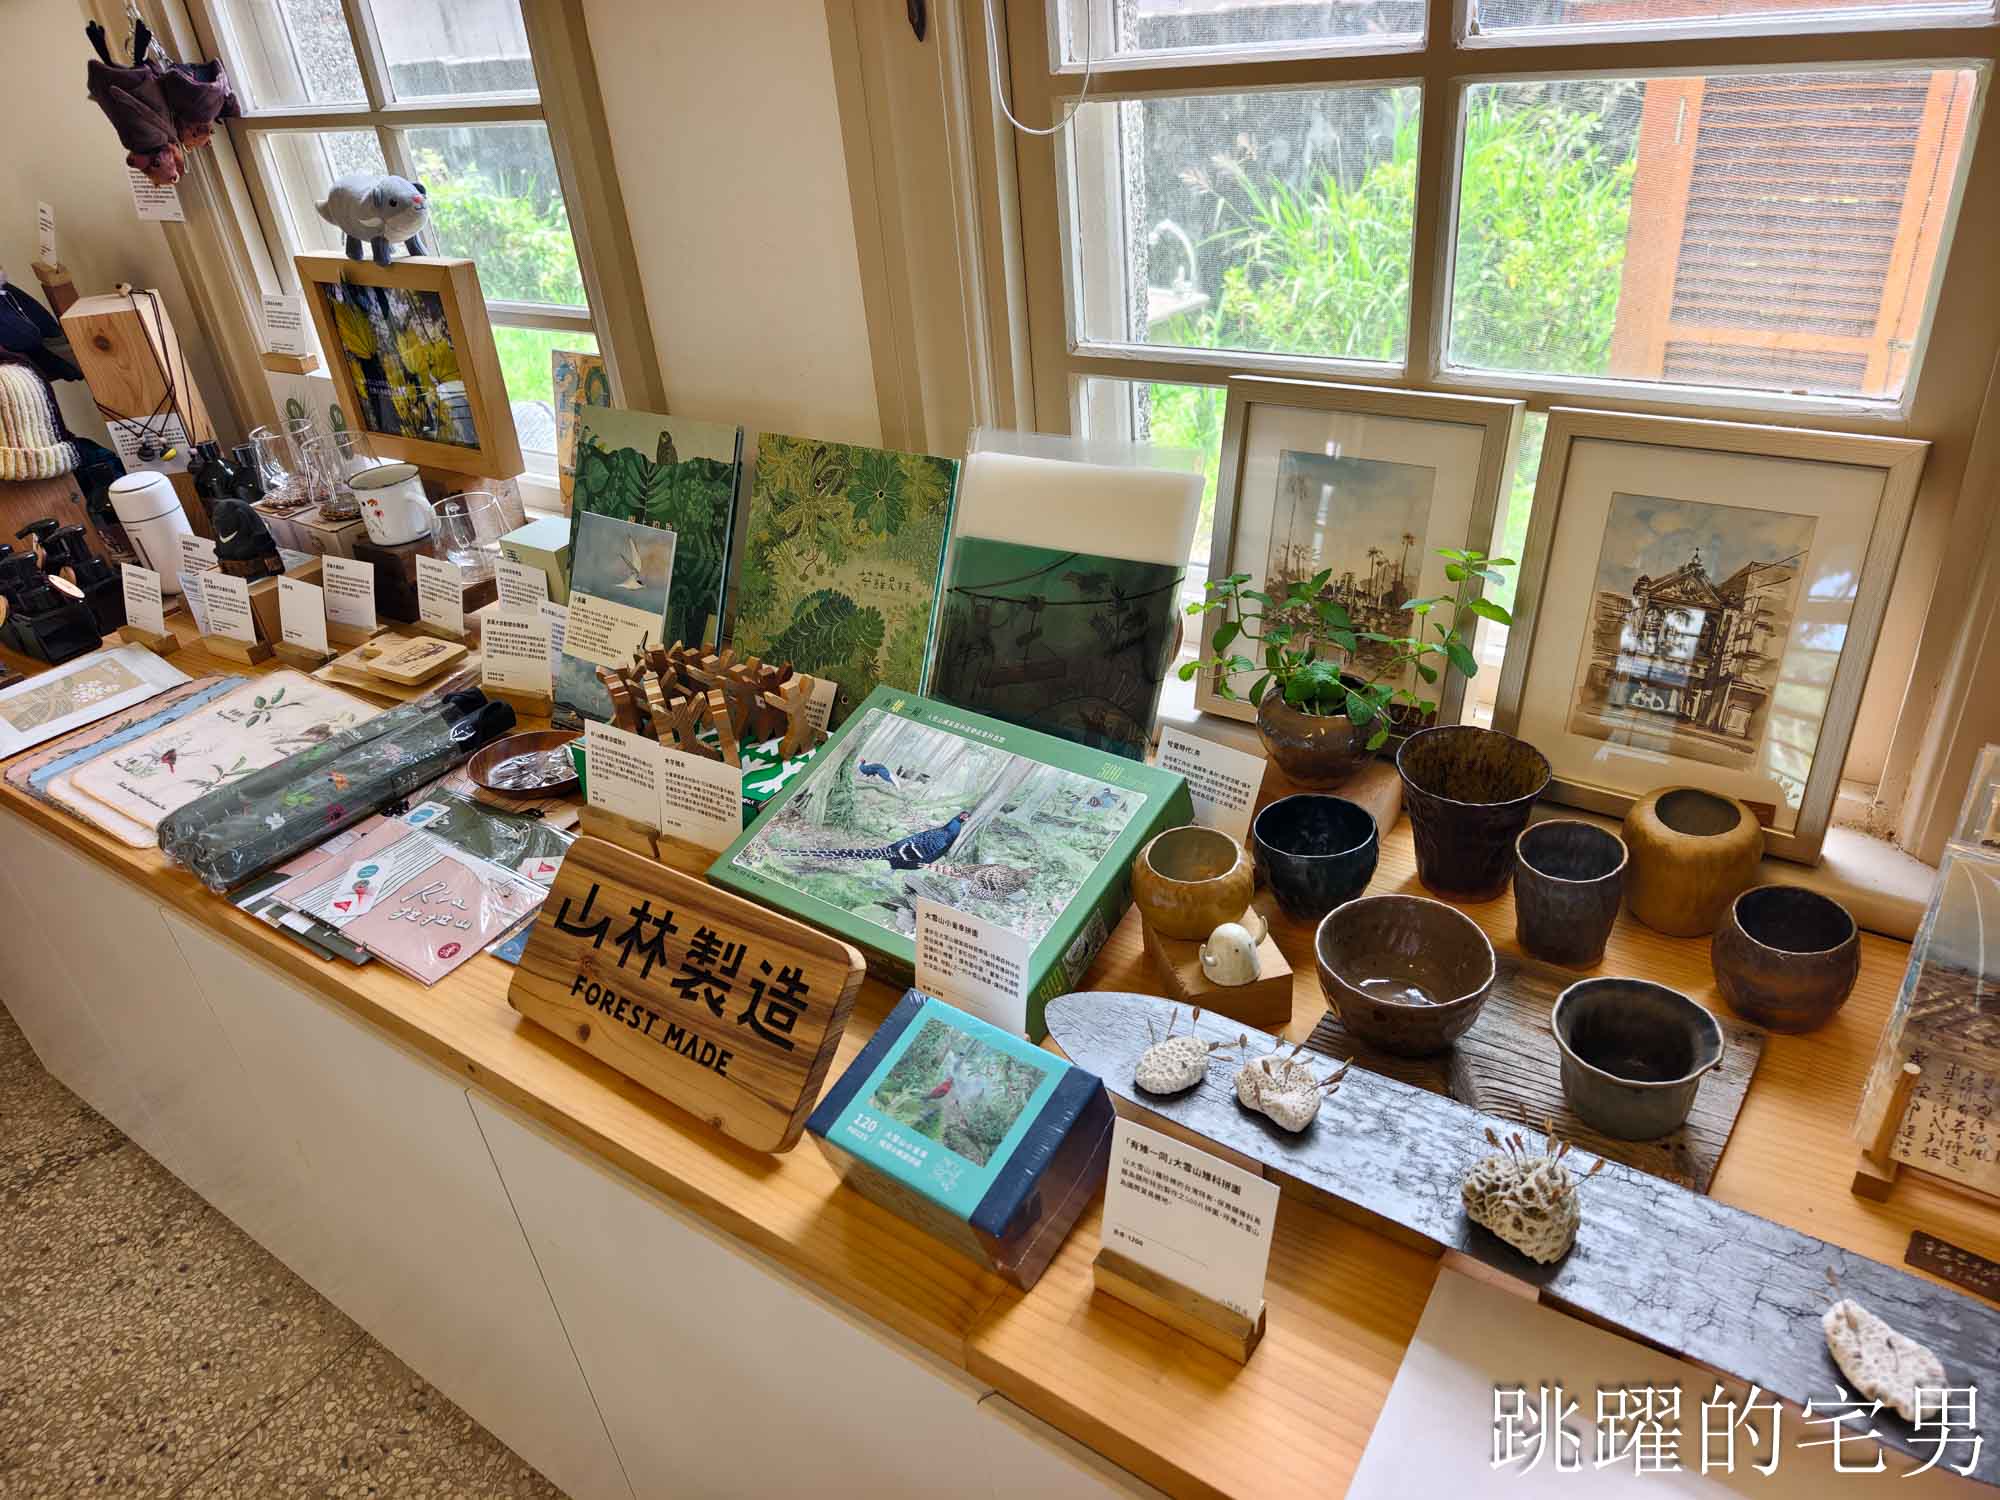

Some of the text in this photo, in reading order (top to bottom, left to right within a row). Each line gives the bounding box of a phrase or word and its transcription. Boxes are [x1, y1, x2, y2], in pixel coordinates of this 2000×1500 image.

[554, 883, 811, 1052] 山林製造
[570, 974, 736, 1078] FOREST MADE
[852, 1112, 879, 1133] 120
